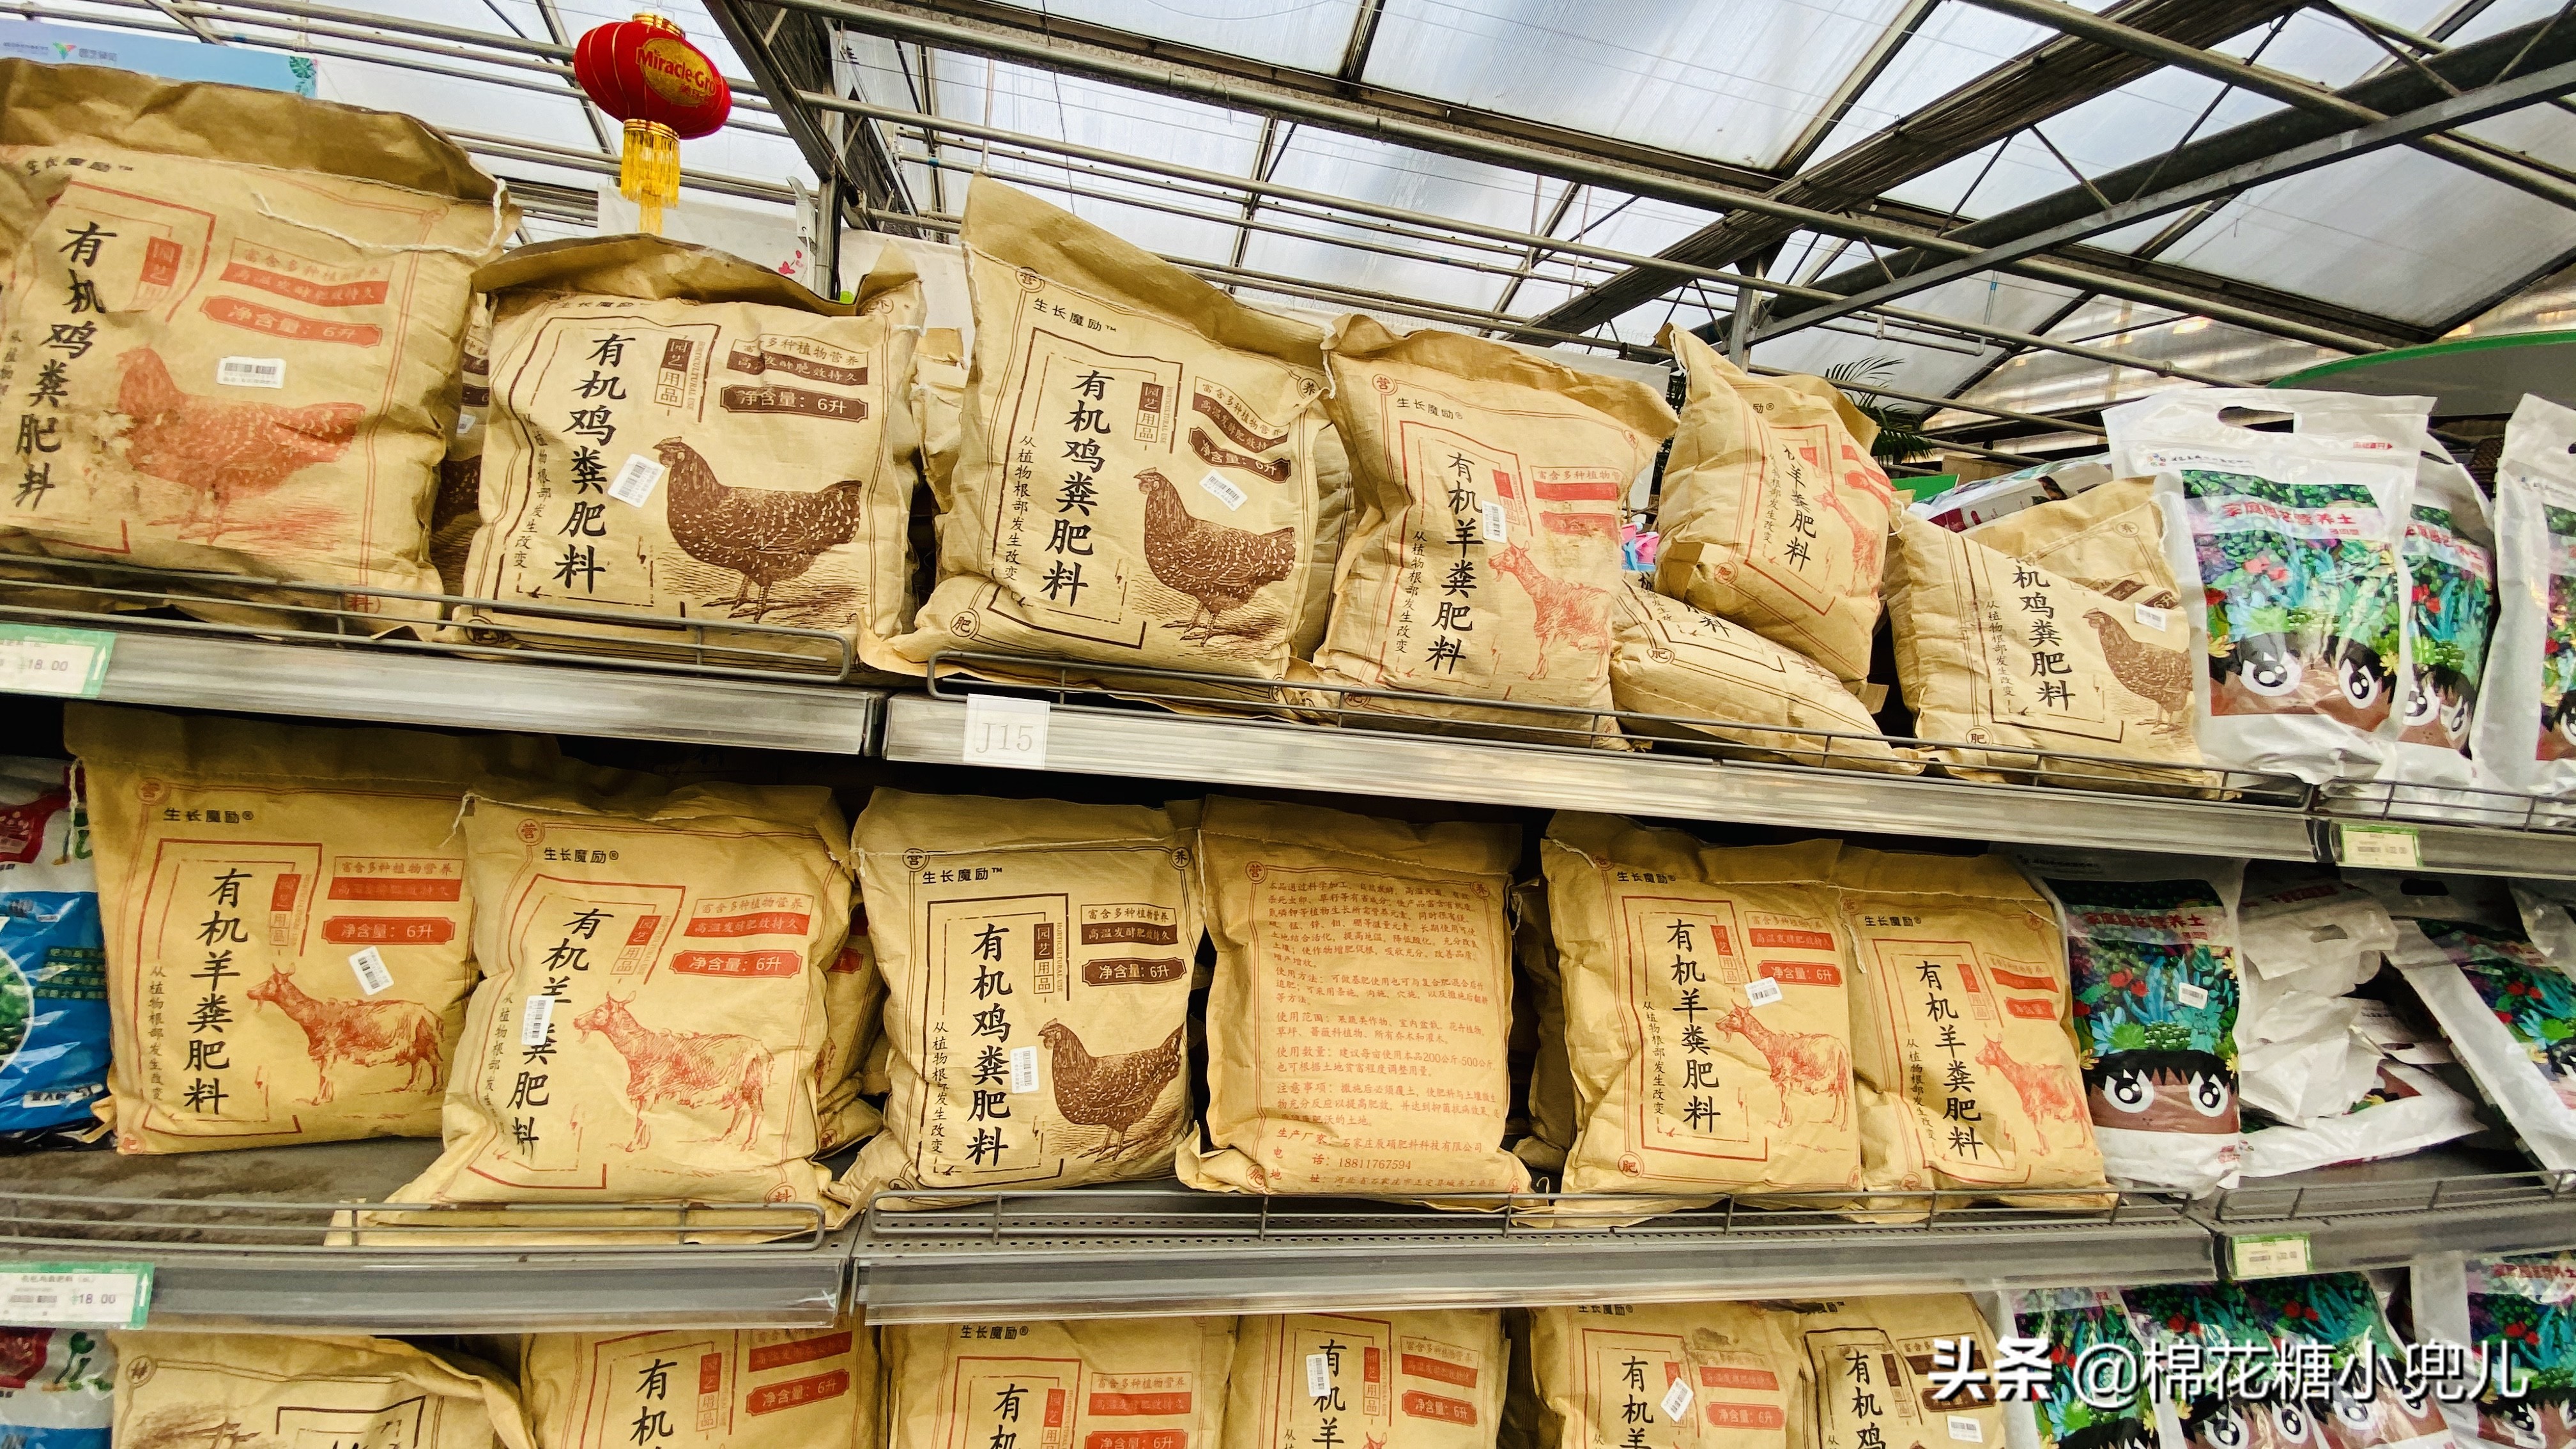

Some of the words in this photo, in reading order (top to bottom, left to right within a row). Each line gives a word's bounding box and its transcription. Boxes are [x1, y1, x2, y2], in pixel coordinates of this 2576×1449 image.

[12, 221, 118, 511] 有机鸡粪肥料
[552, 333, 636, 594] 有机鸡粪肥料
[1004, 435, 1038, 581] 从植物根部发生改变
[1039, 369, 1115, 607] 有机鸡粪肥料
[1395, 531, 1428, 654] 从植物根部发生改变
[1425, 452, 1484, 675] 有机羊粪肥料
[952, 616, 972, 633] 肥
[2011, 560, 2076, 711] 机鸡粪肥料
[975, 722, 1034, 753] J15
[521, 824, 537, 839] 营
[1174, 850, 1187, 864] 养
[1248, 864, 1263, 878] 营
[340, 924, 434, 940] 净含量：6升
[1036, 926, 1052, 990] 园艺用品
[1088, 907, 1170, 922] 富含多种植物营养
[183, 868, 254, 1115] 有机羊粪肥料
[688, 956, 781, 972] 净含量：6升
[1098, 963, 1170, 979] 净含量：6升
[965, 923, 1013, 1167] 有机鸡粪肥料
[1642, 1001, 1666, 1116] 从植物根部发生改变
[1666, 918, 1721, 1133] 有机羊粪肥料
[1915, 960, 1983, 1160] 有机羊粪肥料
[1339, 1158, 1412, 1170] 18811767594
[1622, 1160, 1639, 1174] 肥
